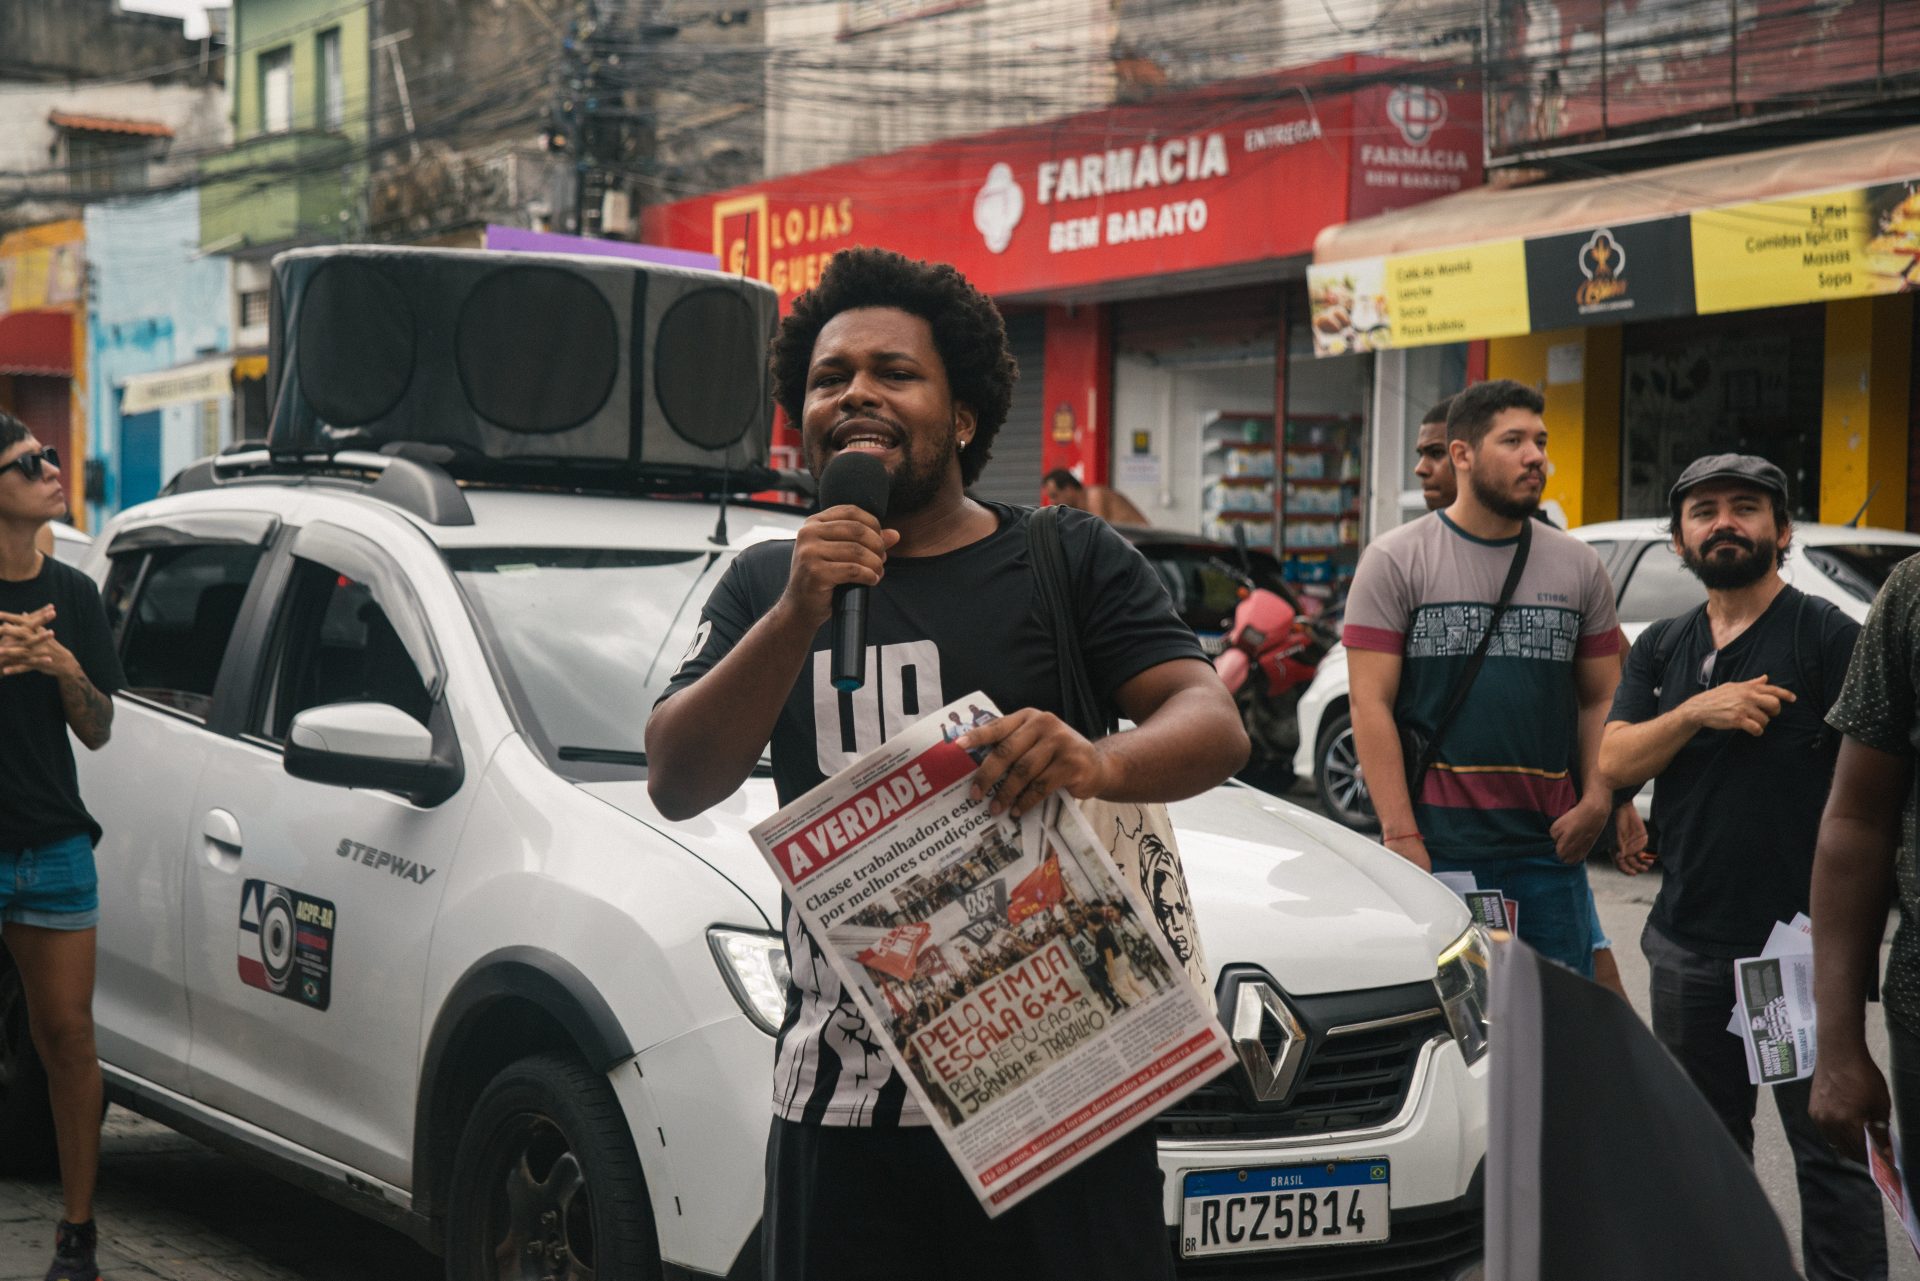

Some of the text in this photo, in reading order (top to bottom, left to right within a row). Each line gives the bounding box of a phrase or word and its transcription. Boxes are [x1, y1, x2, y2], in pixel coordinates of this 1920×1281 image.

[771, 197, 852, 249] LOJAS
[1049, 198, 1207, 253] BEM BARATO
[1803, 249, 1850, 267] Massas
[1819, 271, 1852, 289] Sopa
[787, 841, 814, 879] A
[805, 763, 933, 860] VERDADE
[336, 837, 436, 885] STEPWAY
[805, 875, 853, 912] Classe
[853, 810, 950, 884] trabalhadora
[818, 903, 850, 929] por
[848, 857, 917, 910] melhores
[919, 809, 991, 862] condições
[917, 945, 1069, 1058] PELO FIM DA
[933, 1008, 1023, 1083] ESCALA
[949, 1066, 986, 1097] PELA
[1073, 997, 1091, 1013] DA
[1024, 1050, 1042, 1066] DE
[1039, 1010, 1104, 1059] TRABALHO
[1091, 1079, 1138, 1117] derrotados
[1160, 1047, 1191, 1070] Guerra
[1271, 1175, 1303, 1187] BRASIL
[1185, 1237, 1196, 1252] BR
[1201, 1188, 1366, 1246] RCZ5B14
